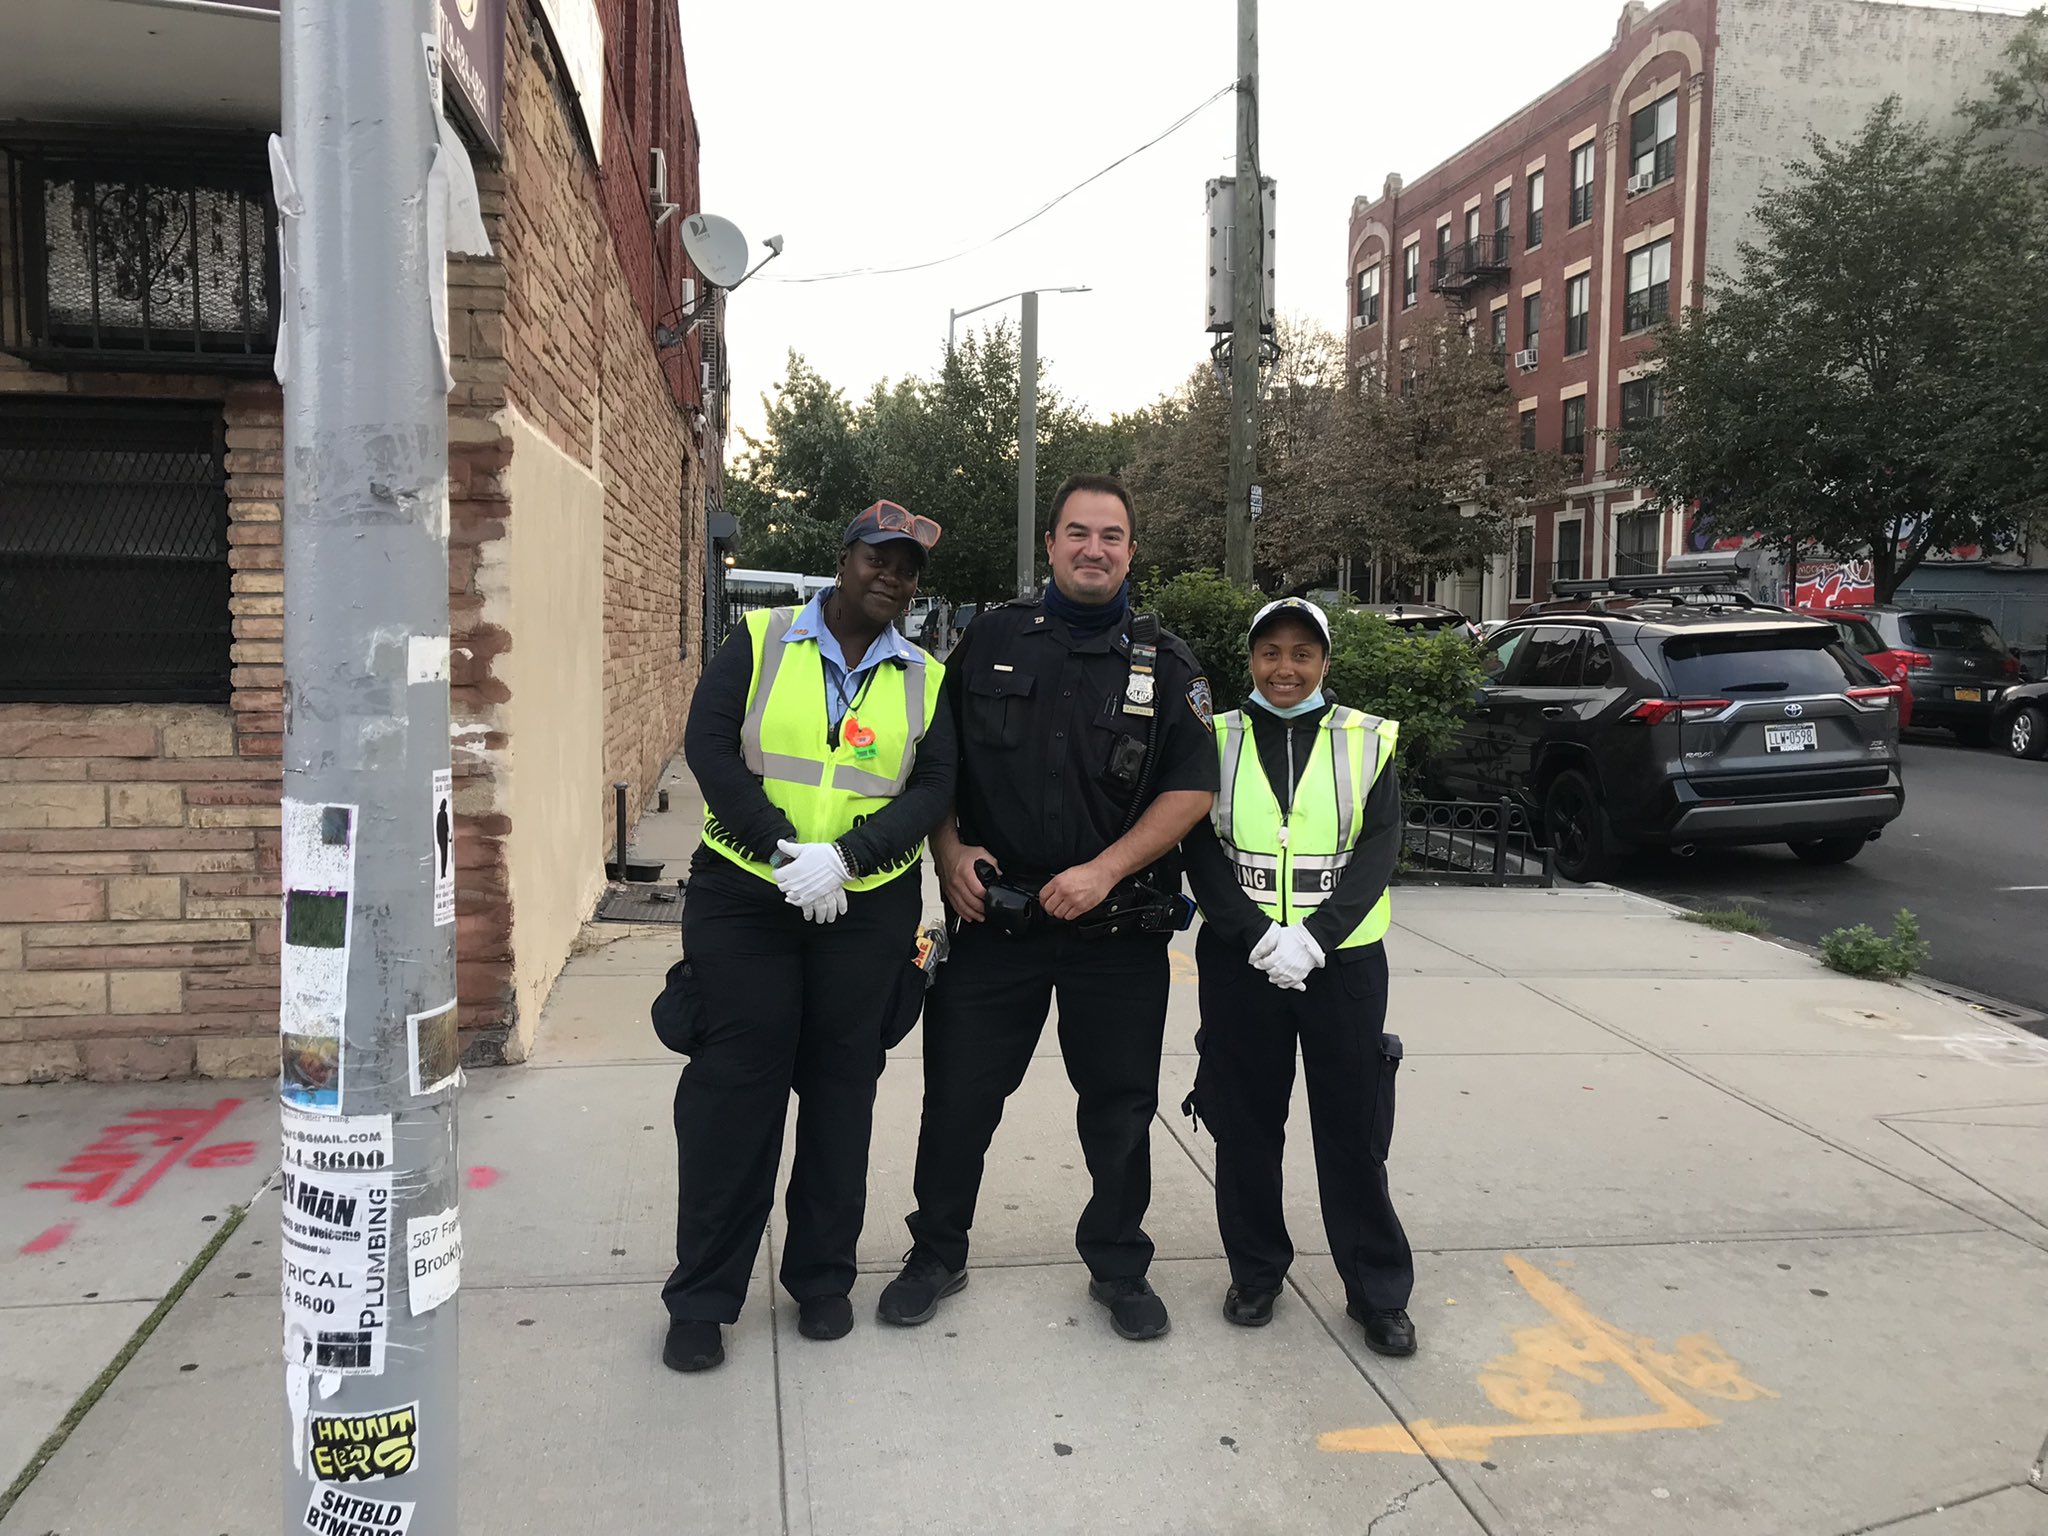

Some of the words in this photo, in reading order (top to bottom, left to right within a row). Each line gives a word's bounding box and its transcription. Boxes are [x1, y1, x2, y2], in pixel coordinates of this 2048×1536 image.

[297, 1181, 357, 1227] MAN
[359, 1189, 387, 1330] PLUMBING
[320, 1489, 402, 1526] SHTBLD
